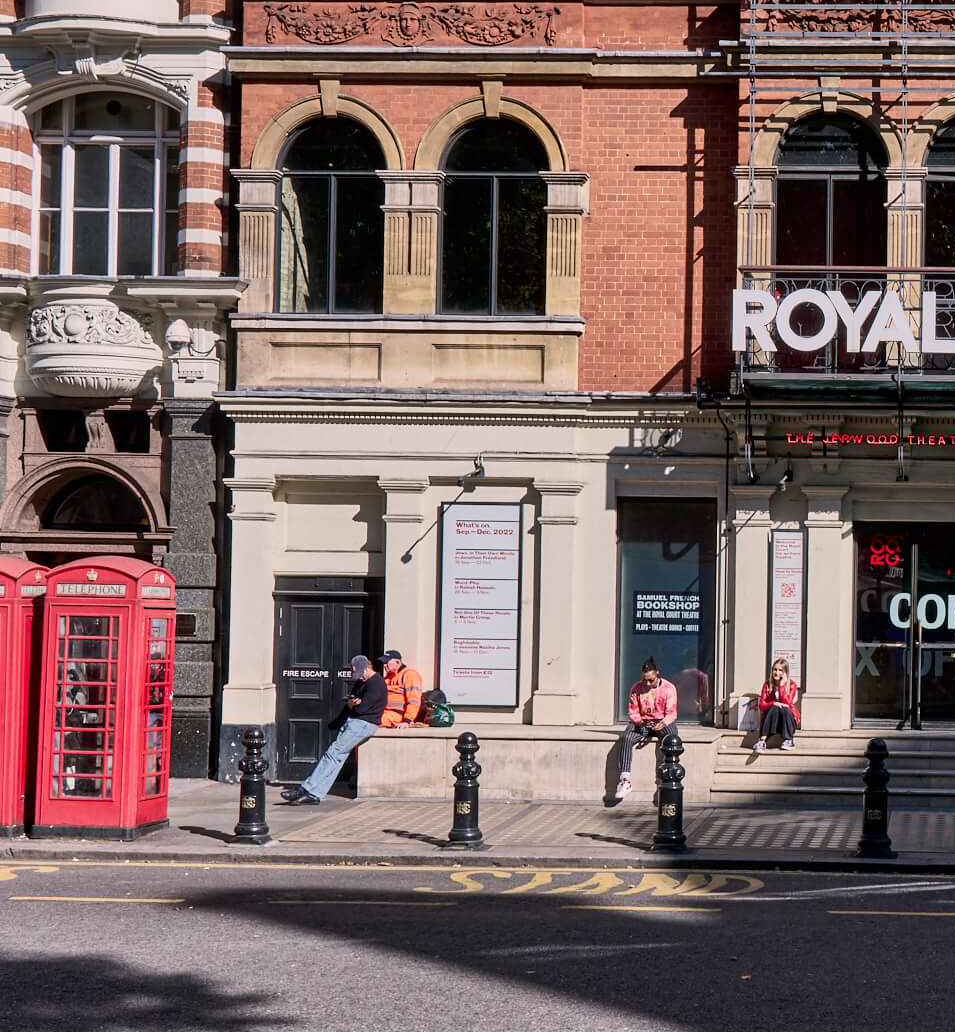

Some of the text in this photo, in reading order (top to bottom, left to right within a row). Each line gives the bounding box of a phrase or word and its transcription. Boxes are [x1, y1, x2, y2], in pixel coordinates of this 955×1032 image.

[785, 432, 814, 444] THE
[60, 584, 124, 595] TELEPHONE
[636, 601, 700, 610] BOOKSHOP
[413, 870, 765, 897] STAND
